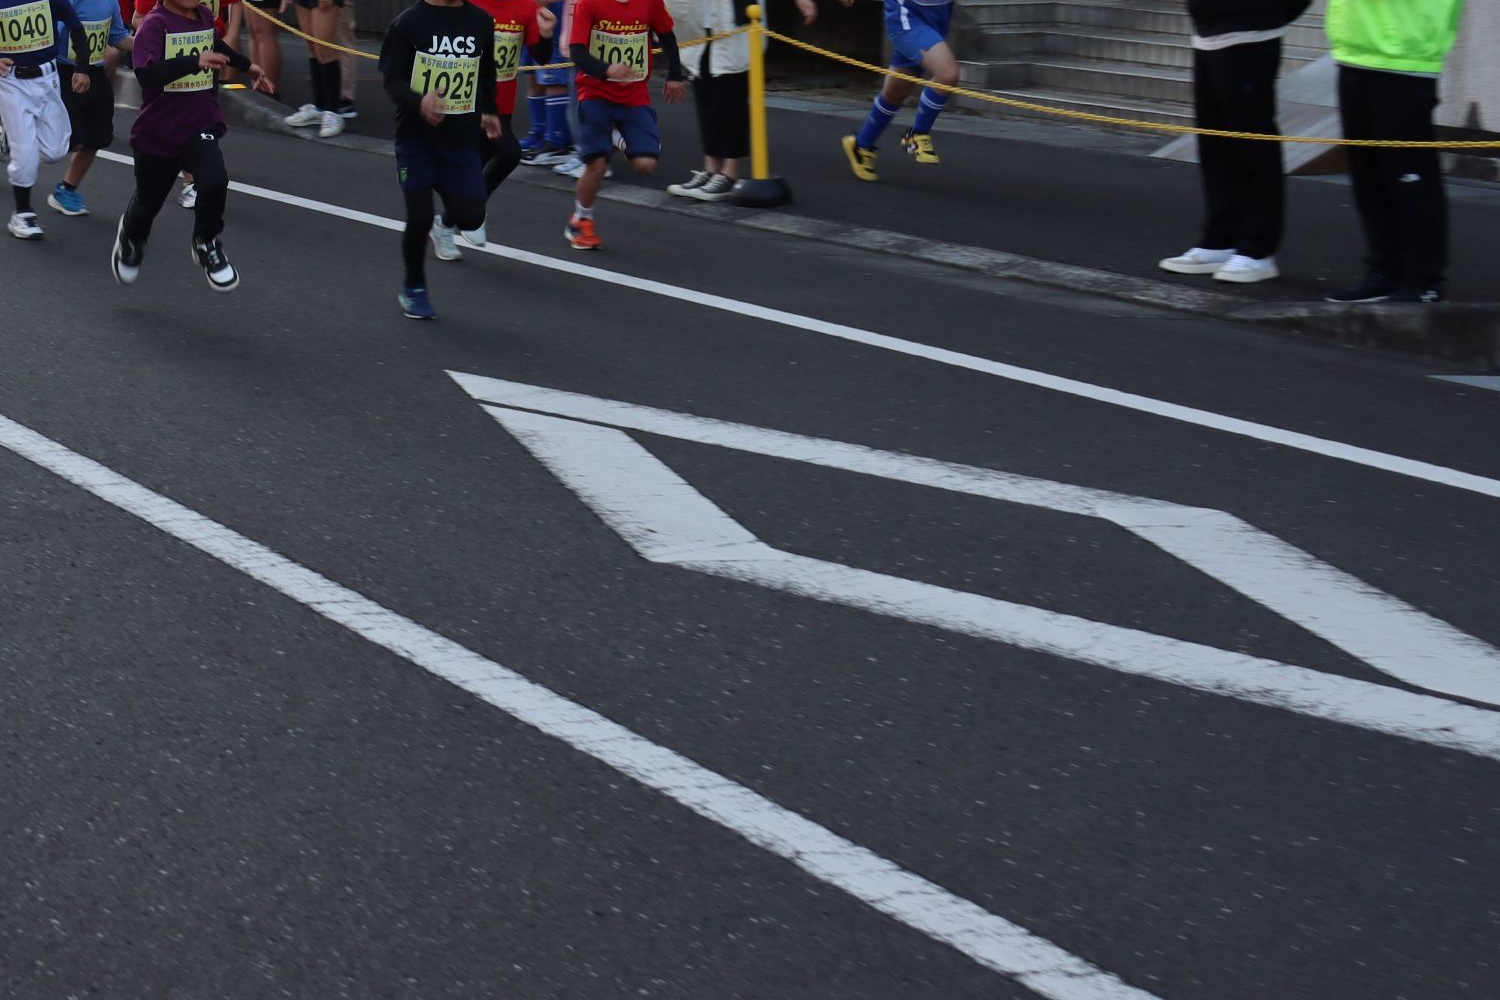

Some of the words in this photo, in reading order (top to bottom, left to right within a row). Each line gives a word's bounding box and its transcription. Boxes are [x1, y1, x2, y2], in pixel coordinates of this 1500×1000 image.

[87, 31, 109, 54] 03
[429, 35, 476, 54] JACS
[494, 44, 517, 70] 32
[597, 44, 645, 69] 1034
[422, 69, 476, 100] 1025
